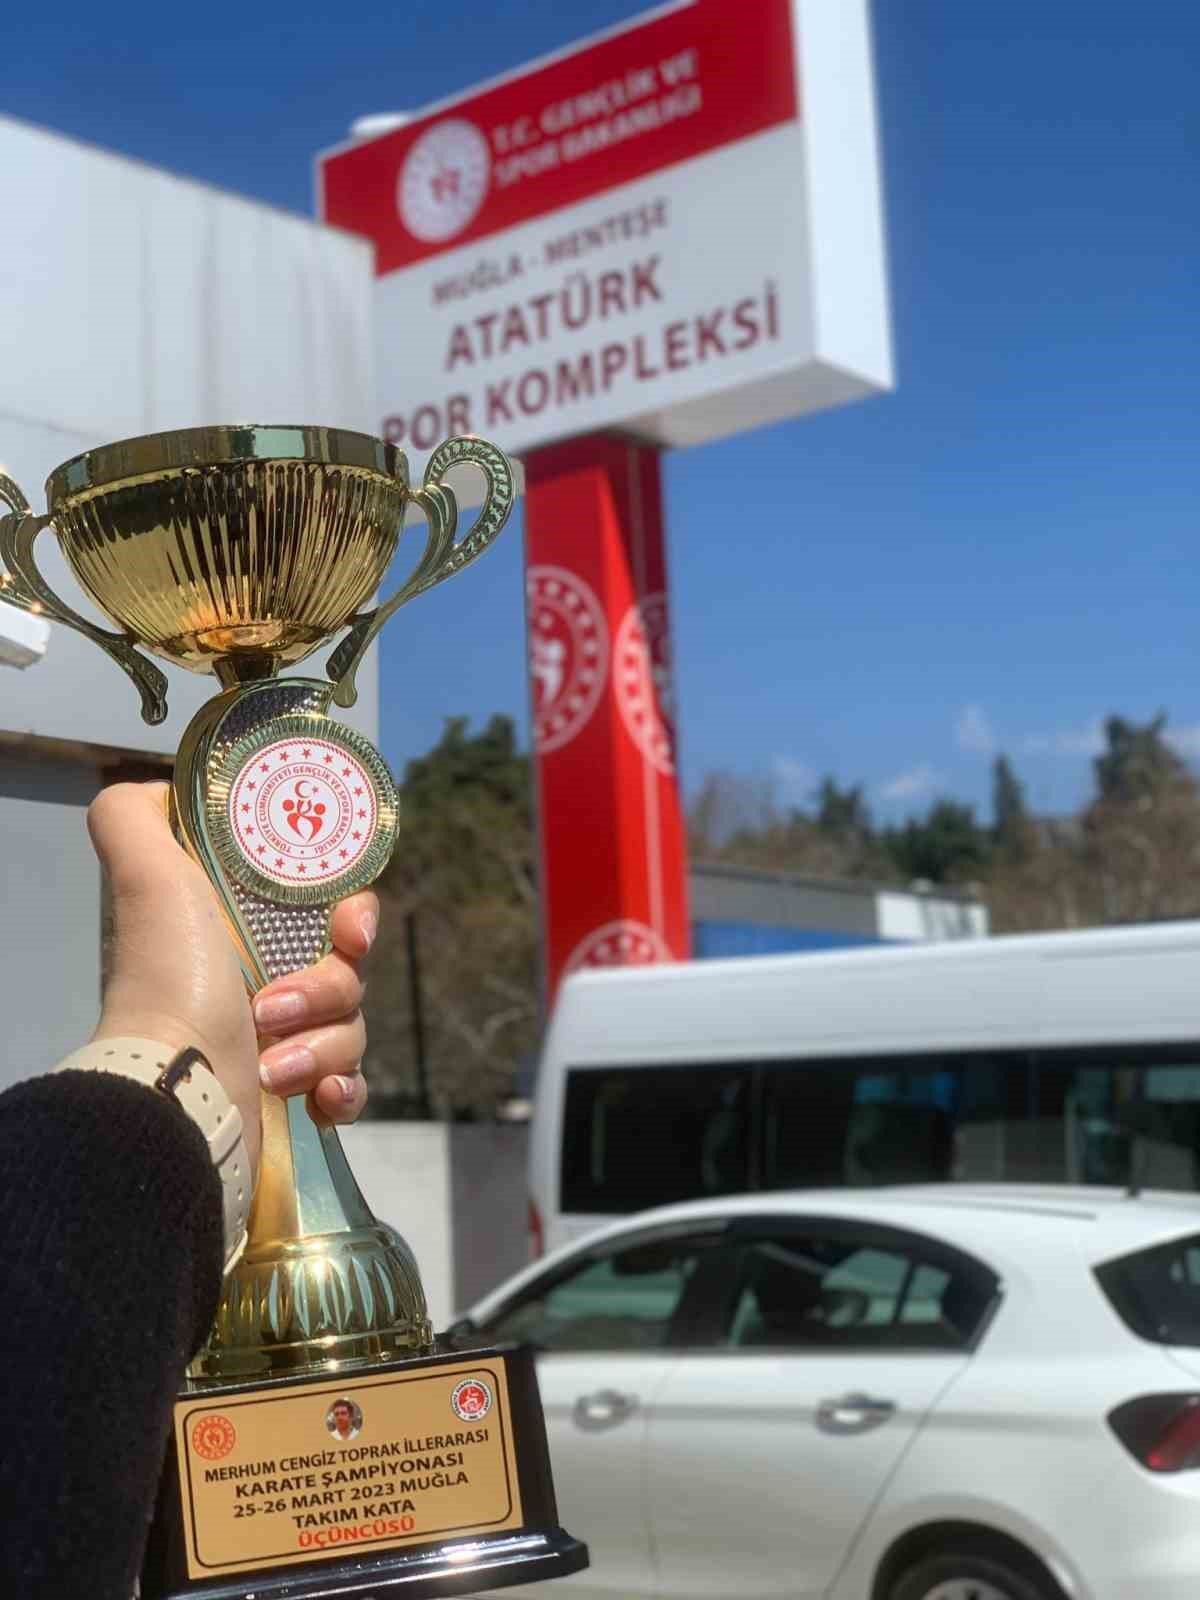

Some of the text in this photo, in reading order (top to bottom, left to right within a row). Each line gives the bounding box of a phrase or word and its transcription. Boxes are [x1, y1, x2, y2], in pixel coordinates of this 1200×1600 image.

[659, 48, 698, 85] VE
[495, 140, 560, 189] SPOR
[444, 256, 663, 371] ATATÜRK
[382, 279, 781, 450] POR KOMPLEKSİ
[204, 1429, 489, 1482] MERHUM CENGİZ TOPRAK İLLERARASI
[235, 1451, 464, 1498] KARATE ŞAMPİYONASI
[233, 1471, 469, 1518] 25-26 MART 2023 MUĞLA
[292, 1499, 415, 1529] TAKIM KATA
[298, 1515, 415, 1548] ÜÇÜNCÜSÜ
